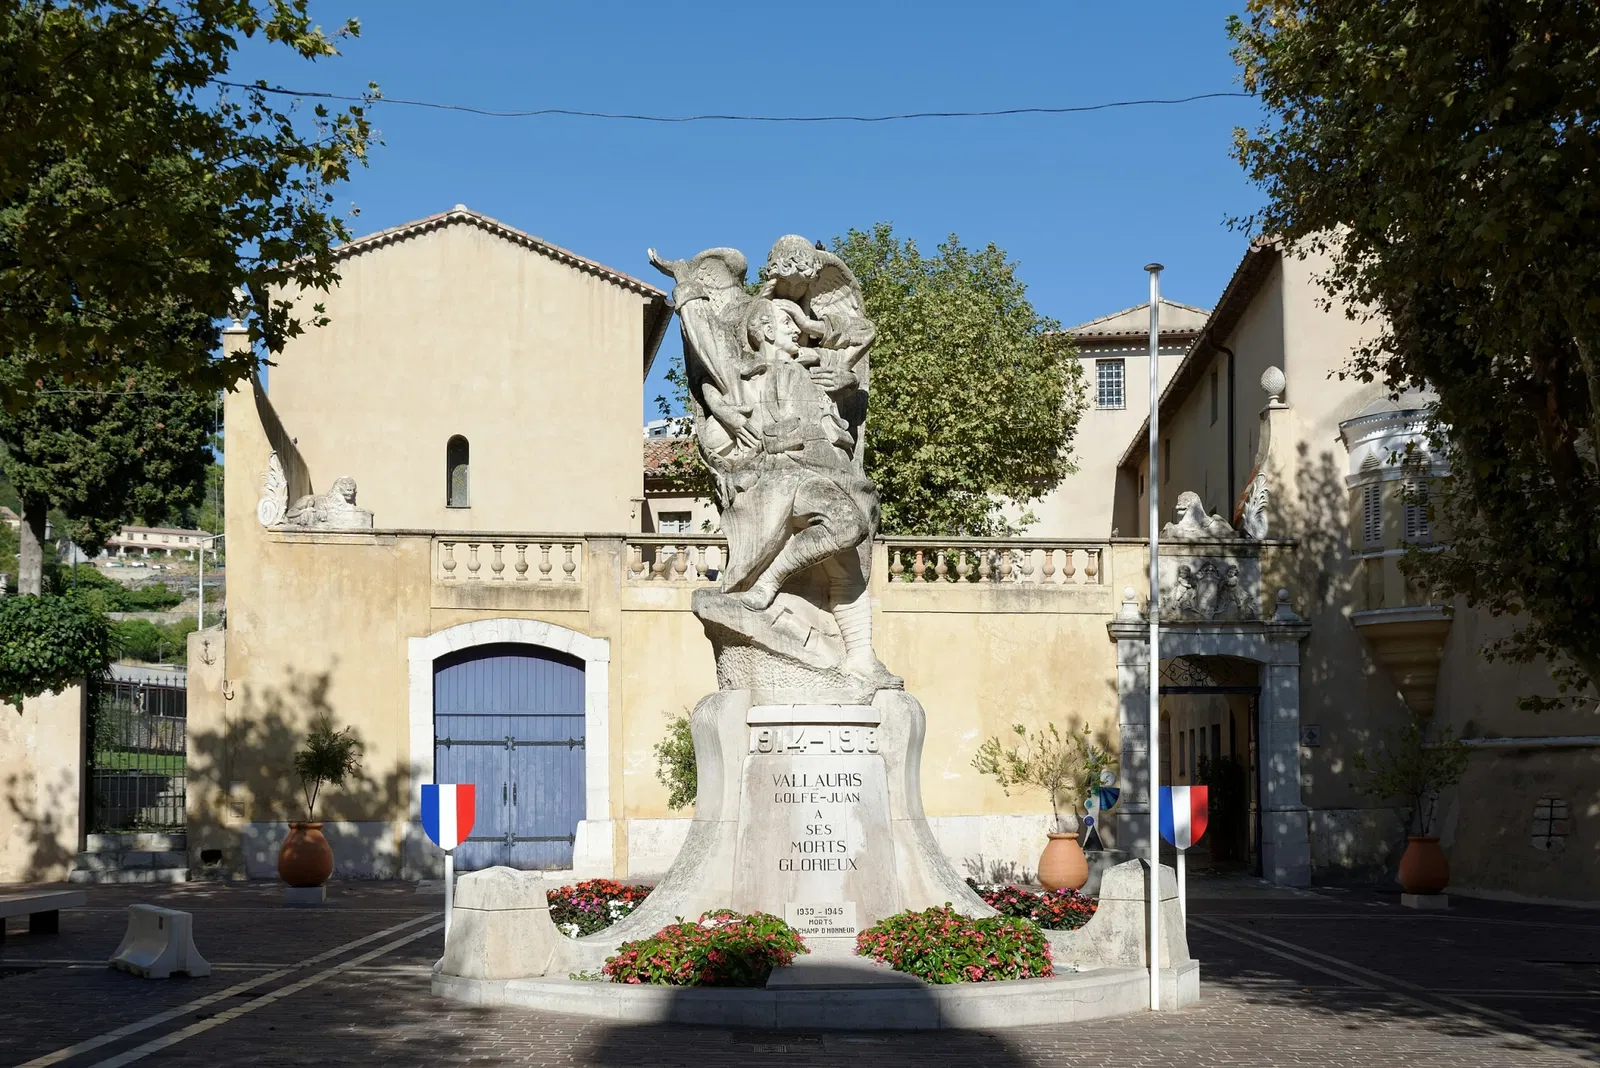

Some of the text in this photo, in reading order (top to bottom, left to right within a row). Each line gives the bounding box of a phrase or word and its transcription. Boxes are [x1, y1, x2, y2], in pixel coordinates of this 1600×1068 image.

[772, 773, 862, 787] VALLAURIS
[774, 792, 861, 804] GOLFE-JUAN
[814, 809, 823, 819] A
[805, 824, 832, 836] SES
[791, 840, 846, 854] MORTS
[779, 858, 858, 872] GLORIEUX
[797, 908, 815, 916] 1939
[825, 907, 843, 916] 1945
[808, 918, 833, 926] MORTS
[797, 927, 819, 935] CHAMP
